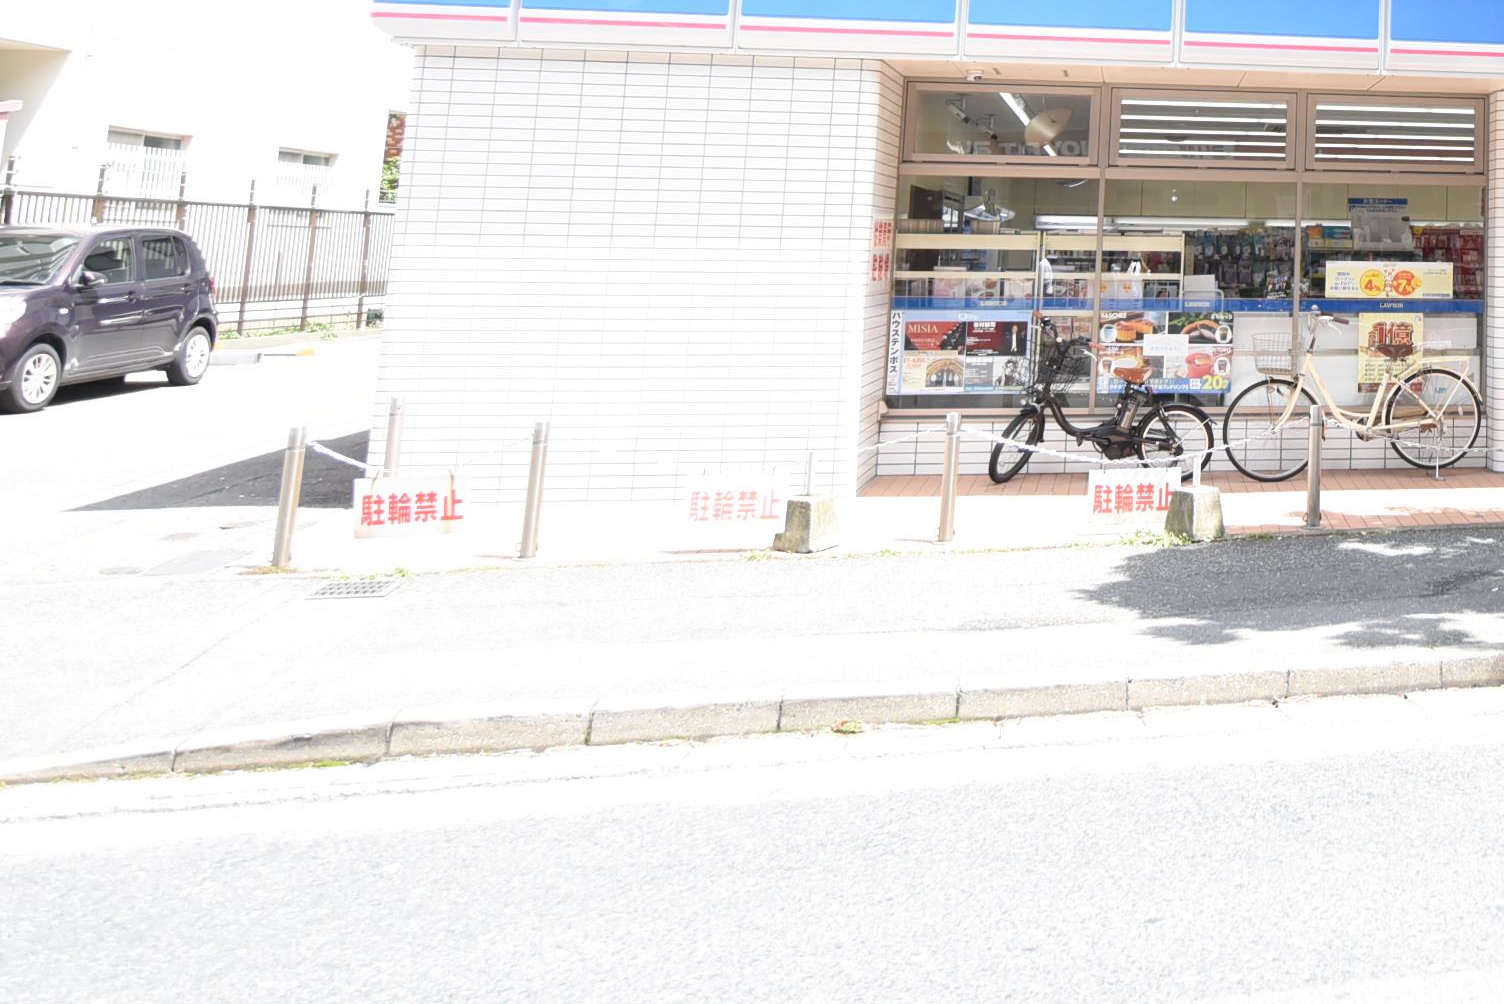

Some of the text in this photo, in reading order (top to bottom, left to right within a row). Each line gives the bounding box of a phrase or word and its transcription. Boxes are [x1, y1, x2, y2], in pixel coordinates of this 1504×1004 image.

[908, 323, 939, 334] MISIA
[360, 488, 464, 526] 駐輪禁止
[687, 488, 781, 522] 駐輪禁止
[1093, 482, 1174, 514] 駐輪禁止
